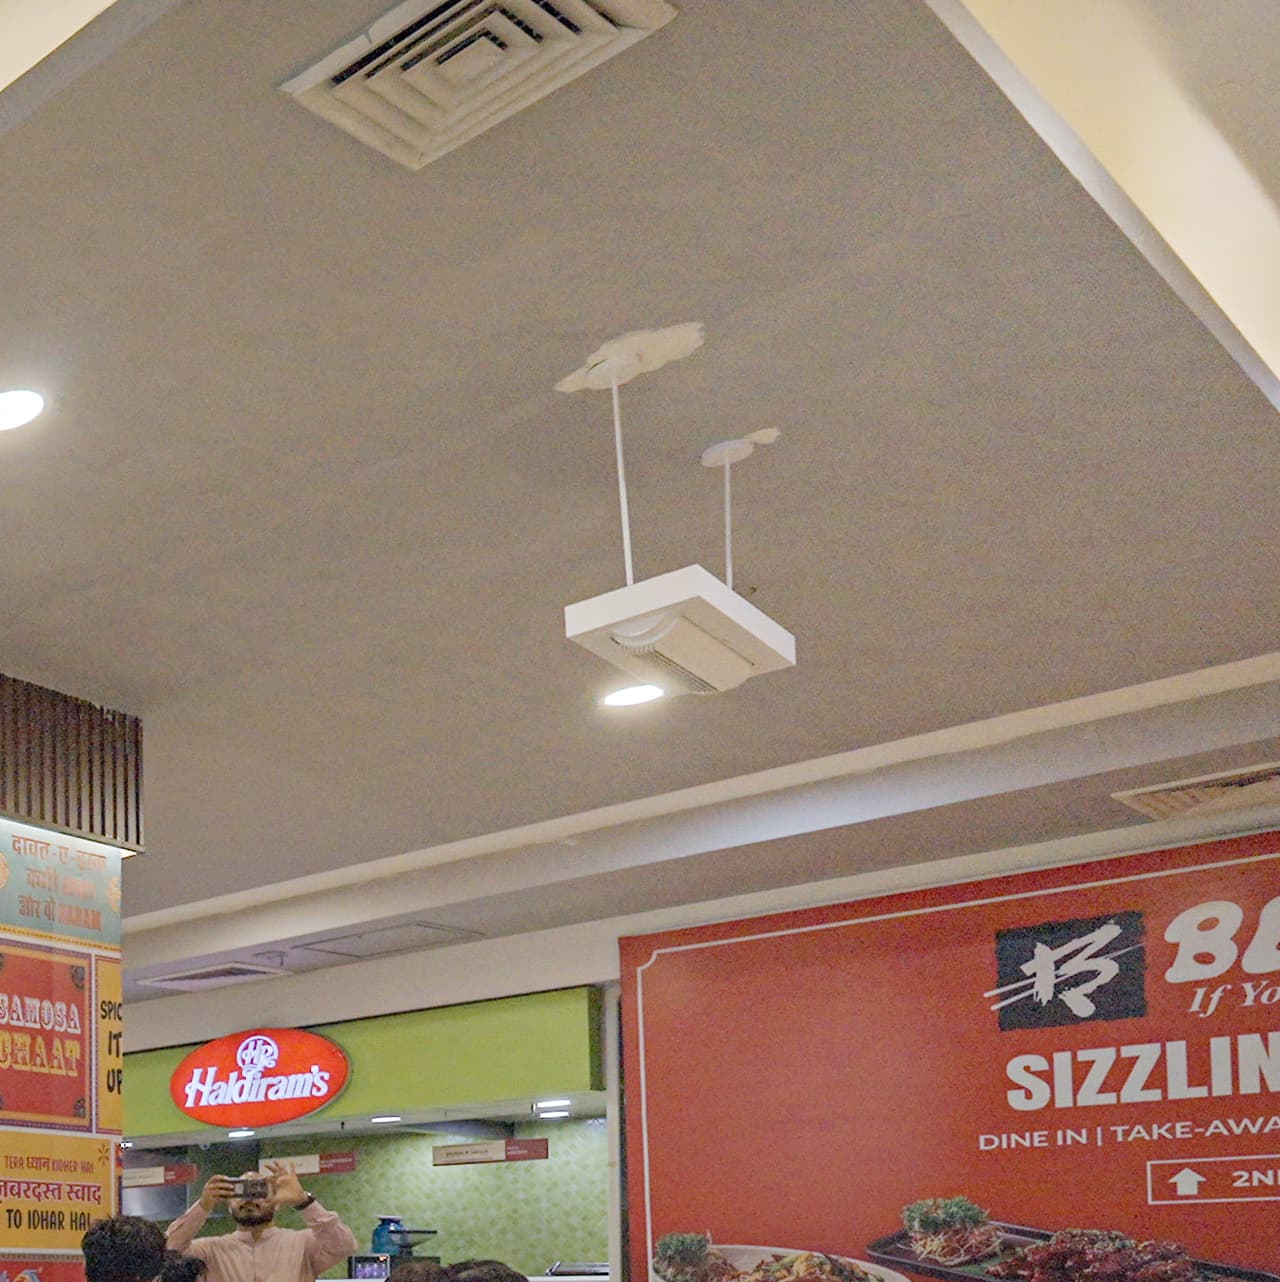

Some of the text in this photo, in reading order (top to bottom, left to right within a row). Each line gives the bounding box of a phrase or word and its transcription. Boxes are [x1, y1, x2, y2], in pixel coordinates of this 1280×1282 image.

[1188, 984, 1233, 1018] If
[184, 1065, 330, 1107] Haldiram's
[979, 1130, 1048, 1150] DINE
[1057, 1128, 1088, 1146] IN
[4, 1156, 24, 1170] TERA
[1232, 1169, 1280, 1188] 2N
[66, 1184, 102, 1205] स्वाद
[6, 1209, 22, 1229] TO
[28, 1209, 65, 1230] IDHAR
